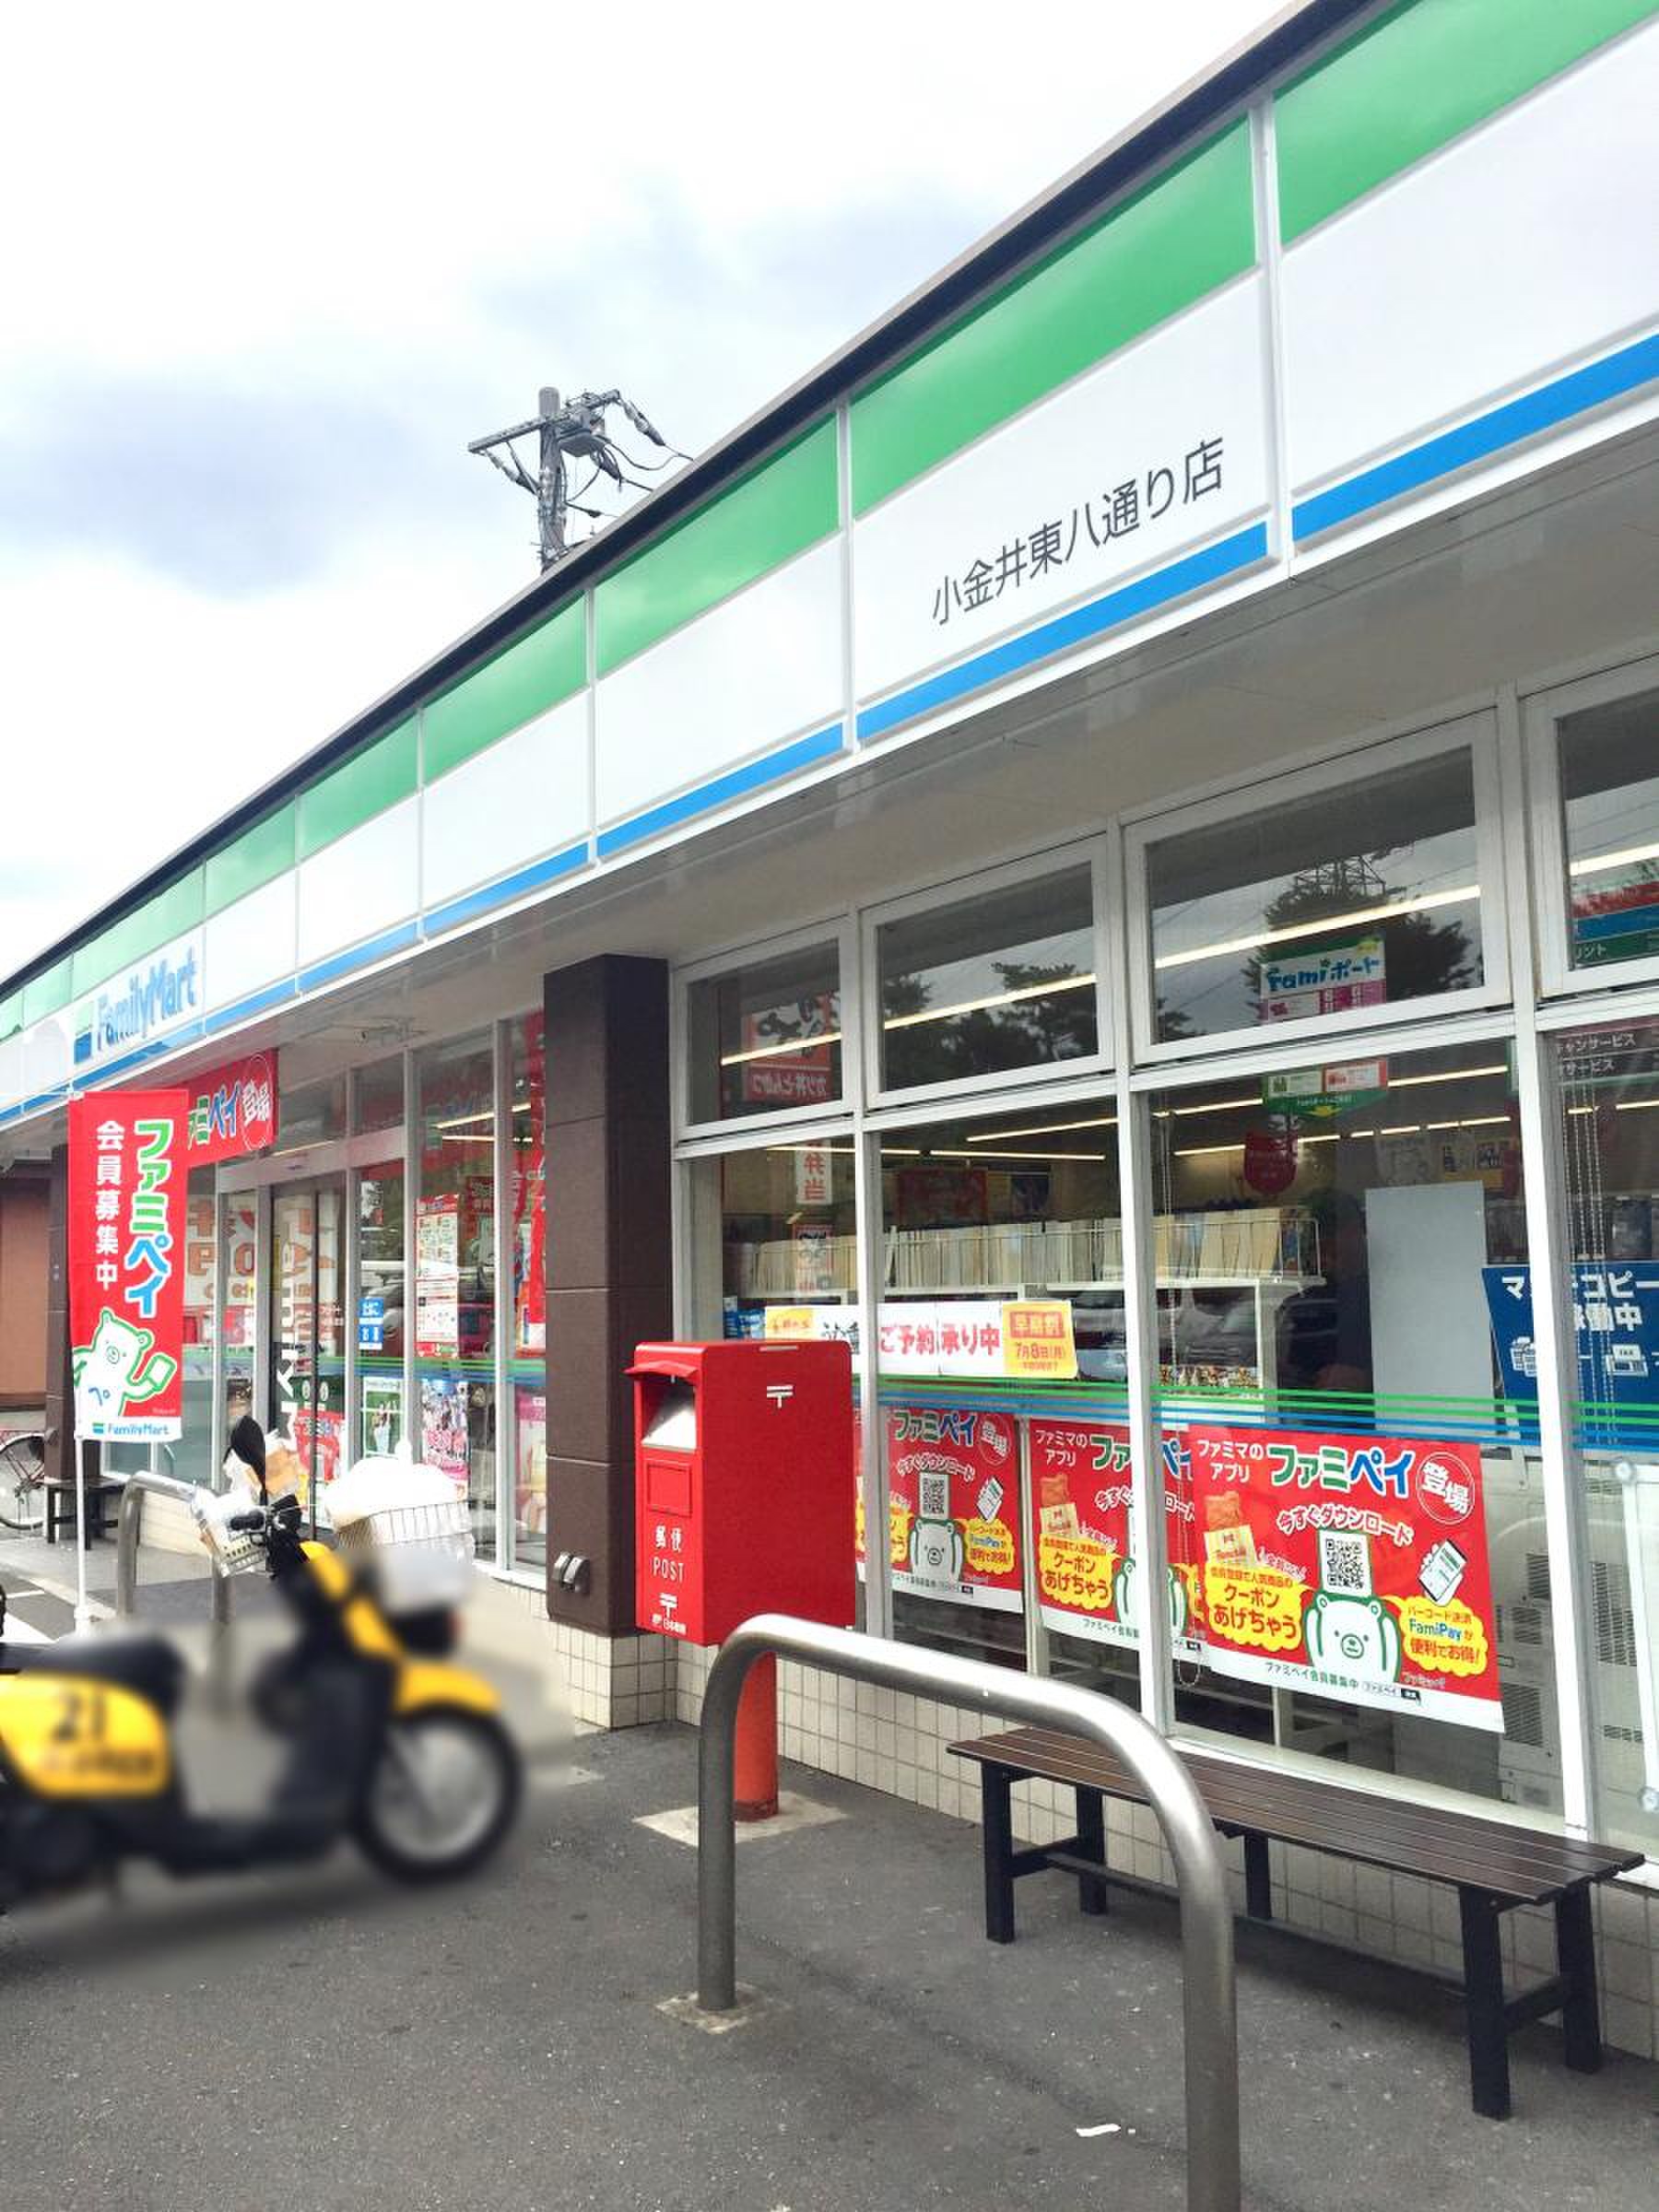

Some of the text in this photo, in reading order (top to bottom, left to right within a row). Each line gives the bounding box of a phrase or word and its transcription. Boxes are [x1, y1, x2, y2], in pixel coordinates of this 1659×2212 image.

[932, 437, 1223, 626] 小金井東八通り店
[97, 947, 196, 1052] FamilyMart
[95, 1120, 125, 1291] 会員募集中
[124, 1119, 175, 1319] ファミペイ
[1502, 1270, 1659, 1301] マコピー
[107, 1422, 170, 1436] FamilyMart
[894, 1410, 978, 1447] ファミペイ
[1036, 1430, 1088, 1449] ファミマの
[1044, 1448, 1077, 1468] アプリ
[1197, 1439, 1265, 1461] ファミマの
[1209, 1462, 1252, 1484] アプリ
[1267, 1442, 1469, 1514] ファミペイ 登場
[1277, 1502, 1415, 1547] 今すぐダウンロード
[653, 1557, 684, 1583] POST
[1053, 1551, 1097, 1574] クーポン
[1044, 1570, 1110, 1601] あげちゃう
[1224, 1582, 1280, 1609] クーポン
[1212, 1603, 1298, 1640] あげちゃう
[1408, 1618, 1463, 1642] FamiPay
